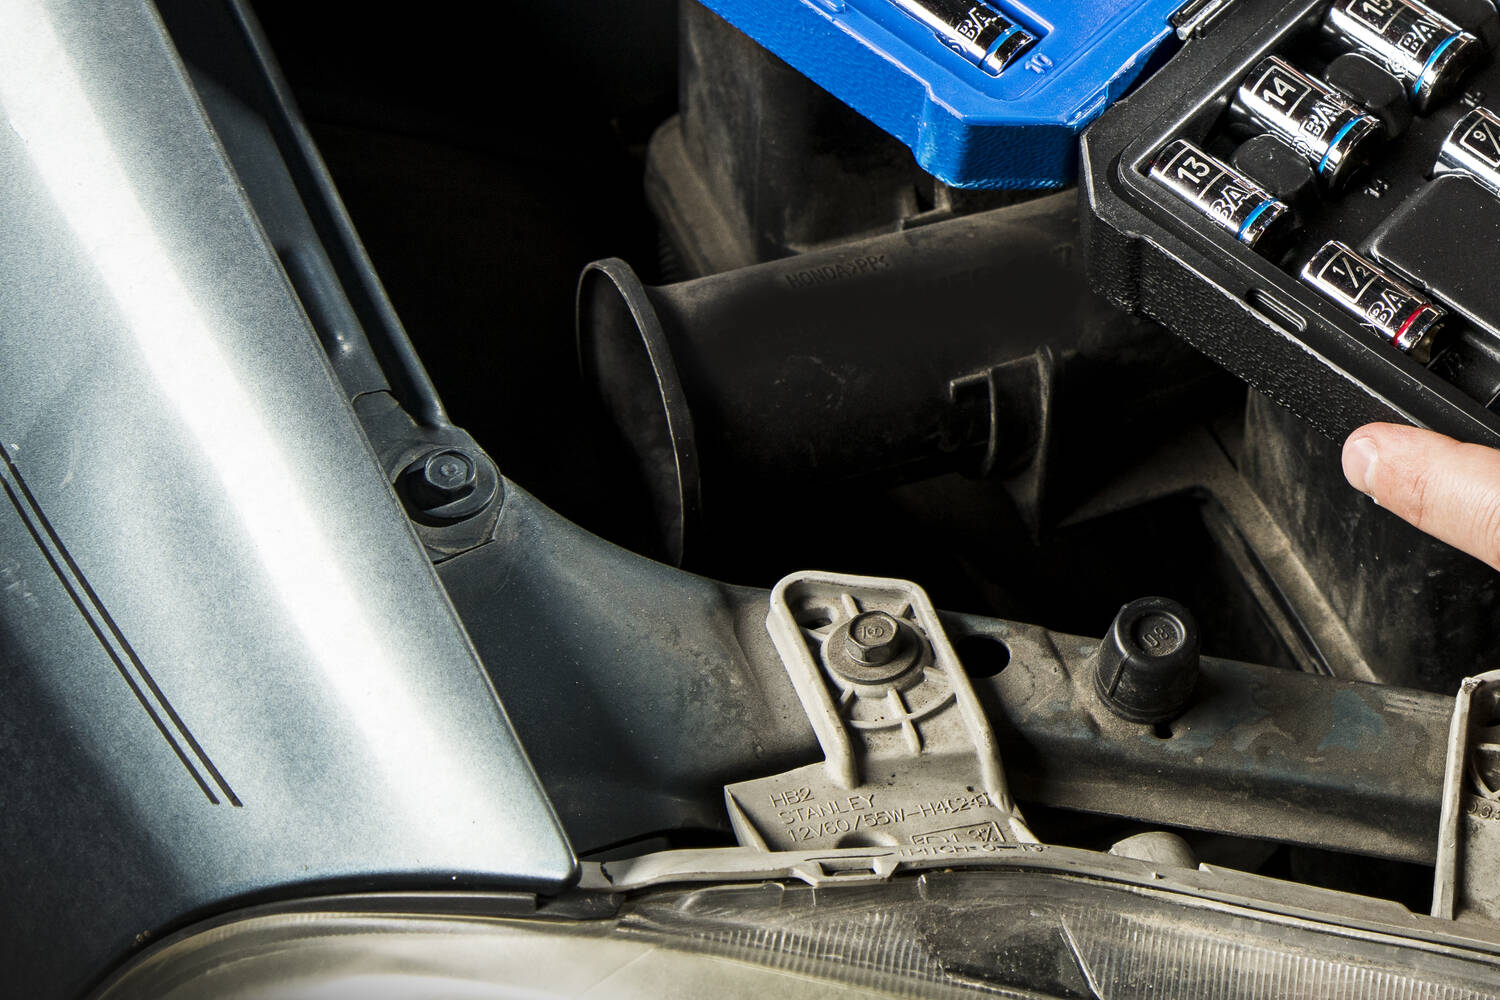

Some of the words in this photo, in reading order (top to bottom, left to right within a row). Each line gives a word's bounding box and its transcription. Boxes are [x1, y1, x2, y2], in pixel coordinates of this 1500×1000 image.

[1024, 52, 1055, 74] 10
[1262, 76, 1298, 107] 14
[1176, 155, 1211, 185] 13
[1331, 256, 1372, 289] 1/2
[768, 786, 815, 809] HB2
[777, 793, 876, 826] STANLEY
